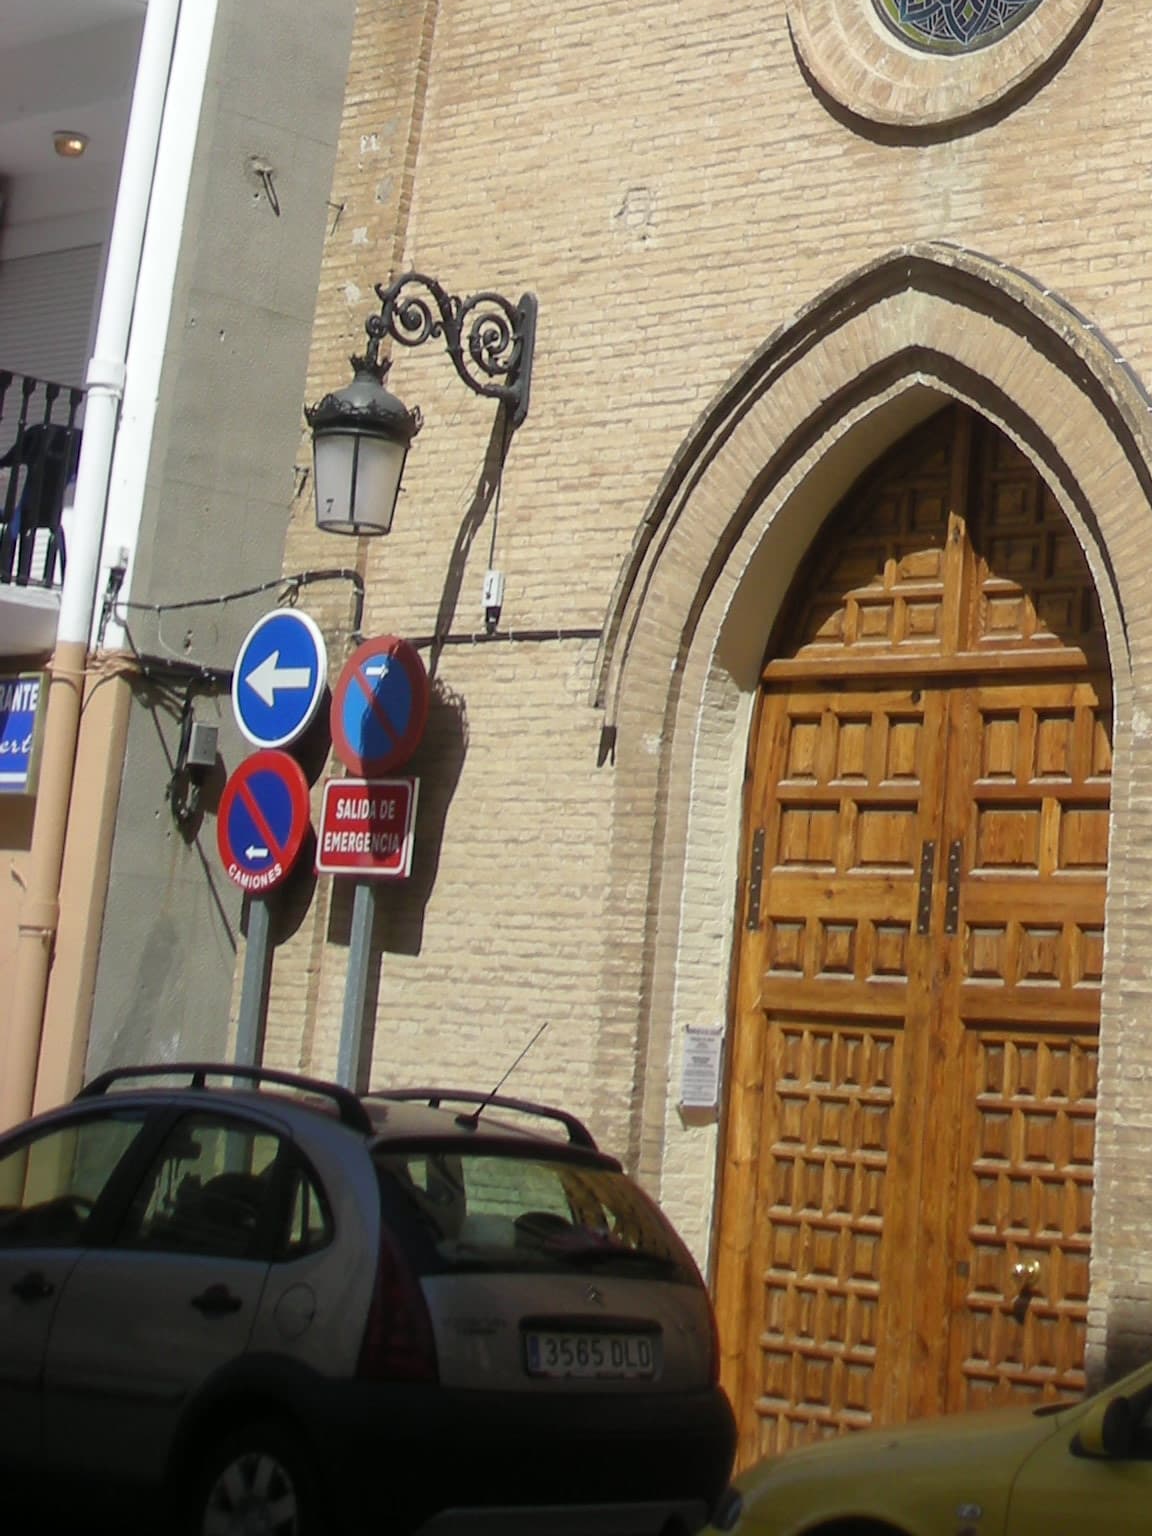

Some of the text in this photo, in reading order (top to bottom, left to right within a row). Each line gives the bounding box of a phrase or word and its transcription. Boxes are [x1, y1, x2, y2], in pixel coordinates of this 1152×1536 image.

[335, 798, 397, 820] SALIDA DE
[323, 831, 400, 853] EMERGENCIA
[228, 863, 282, 889] CAMIONES
